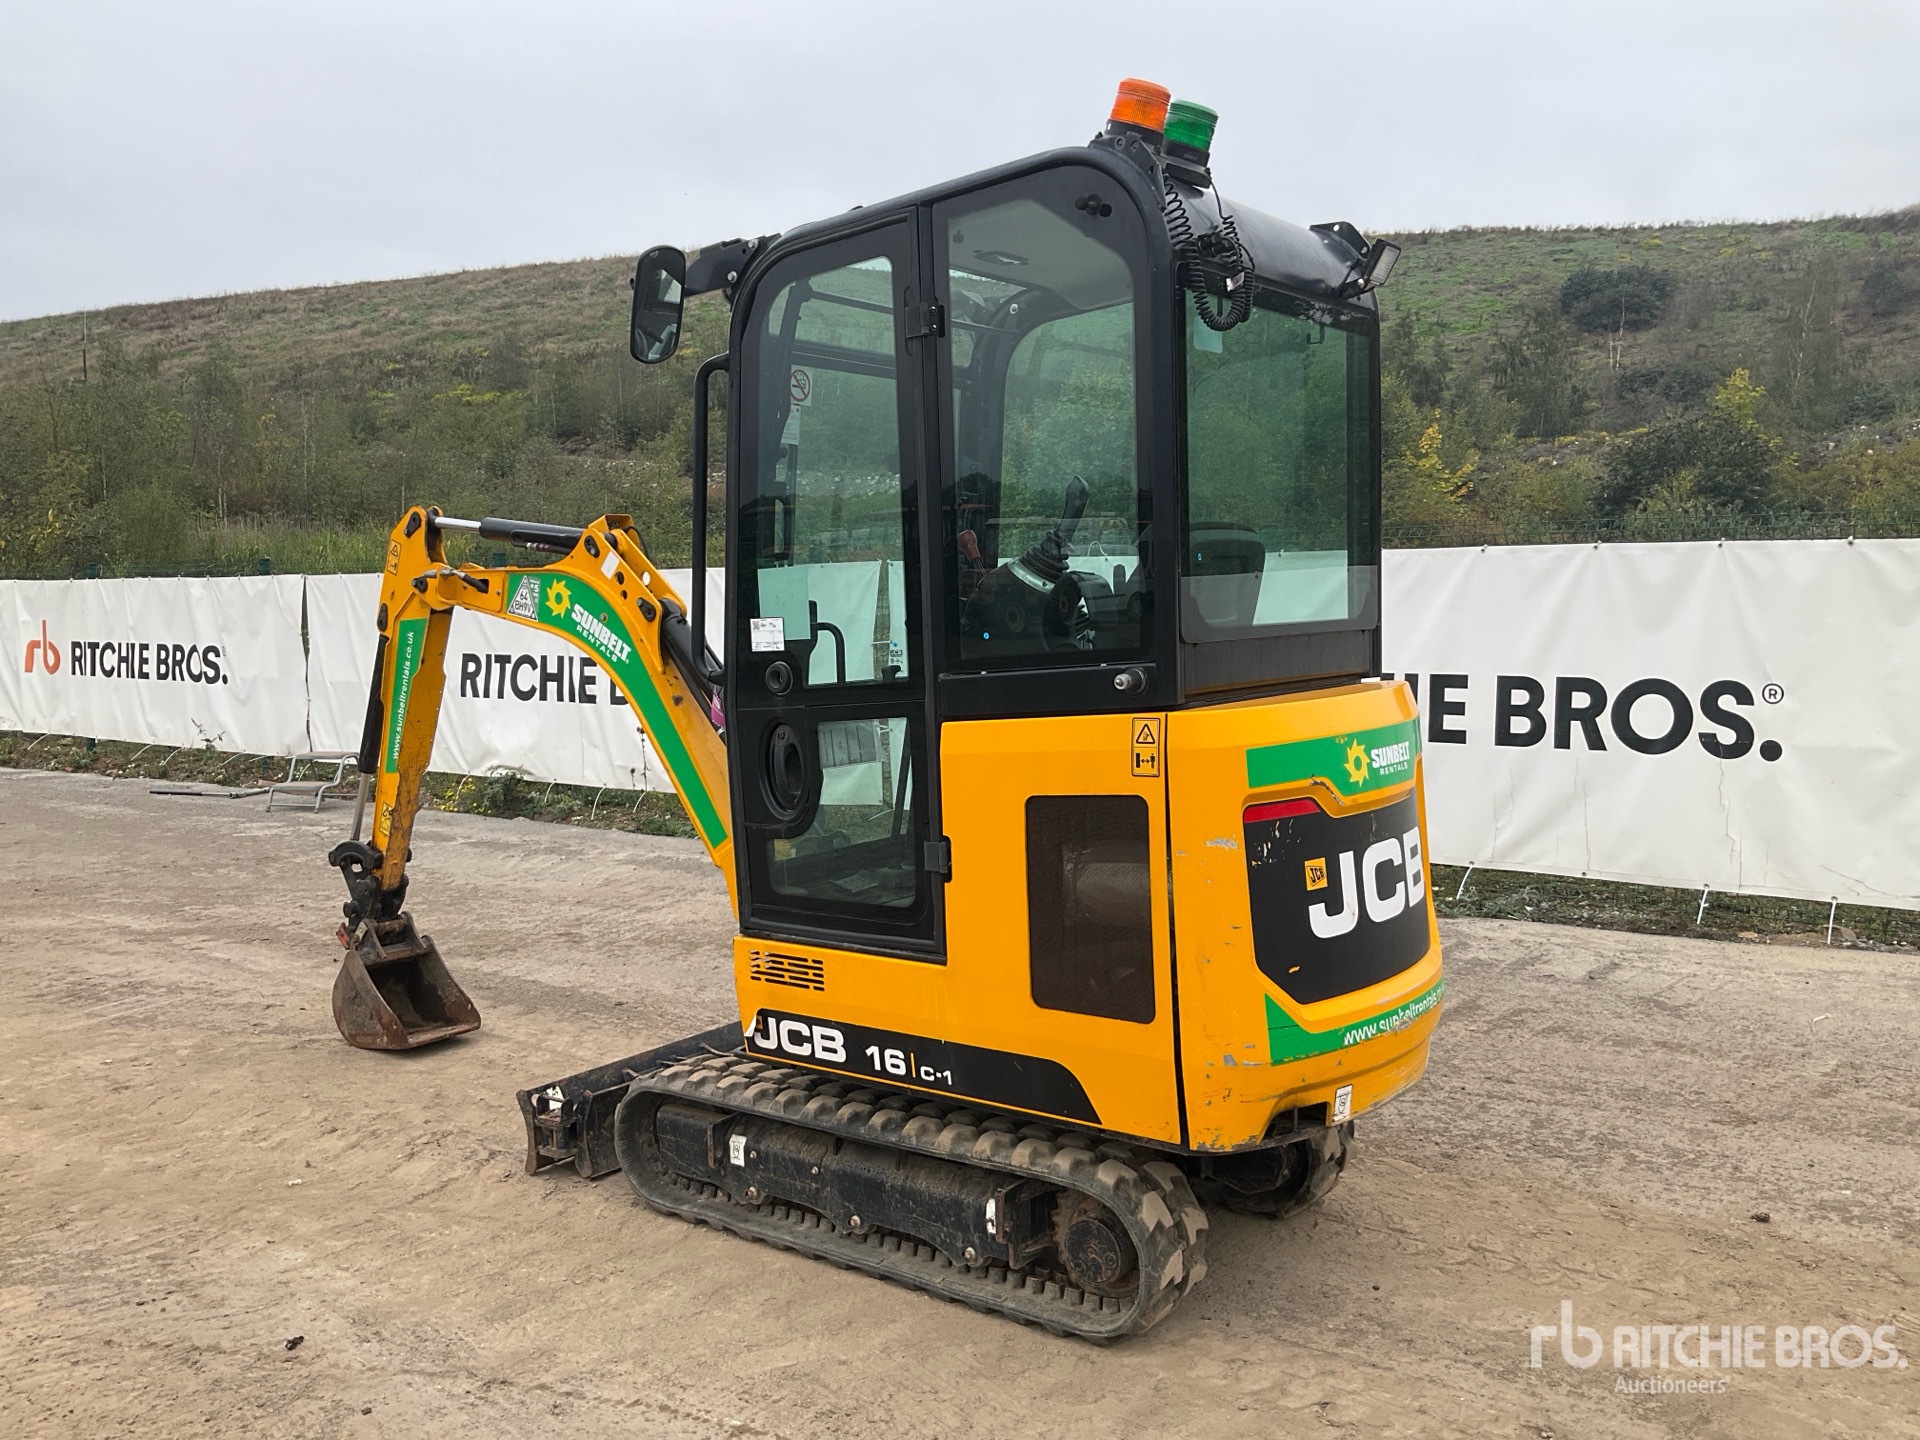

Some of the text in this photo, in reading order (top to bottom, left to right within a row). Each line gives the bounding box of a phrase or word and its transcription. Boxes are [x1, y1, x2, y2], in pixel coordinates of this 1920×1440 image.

[571, 603, 632, 662] SUNBELT
[576, 624, 618, 663] RENTALS
[70, 640, 150, 680] RITCHIE
[156, 642, 229, 686] BROS.
[460, 652, 598, 705] RITCHIE
[393, 631, 414, 759] www.sunbeltrentals.co.uk
[1371, 741, 1410, 768] SUNBELT
[1380, 761, 1408, 776] RENTALS
[1308, 826, 1425, 939] JCB
[1309, 867, 1325, 884] JCB
[753, 1016, 847, 1063] JCB
